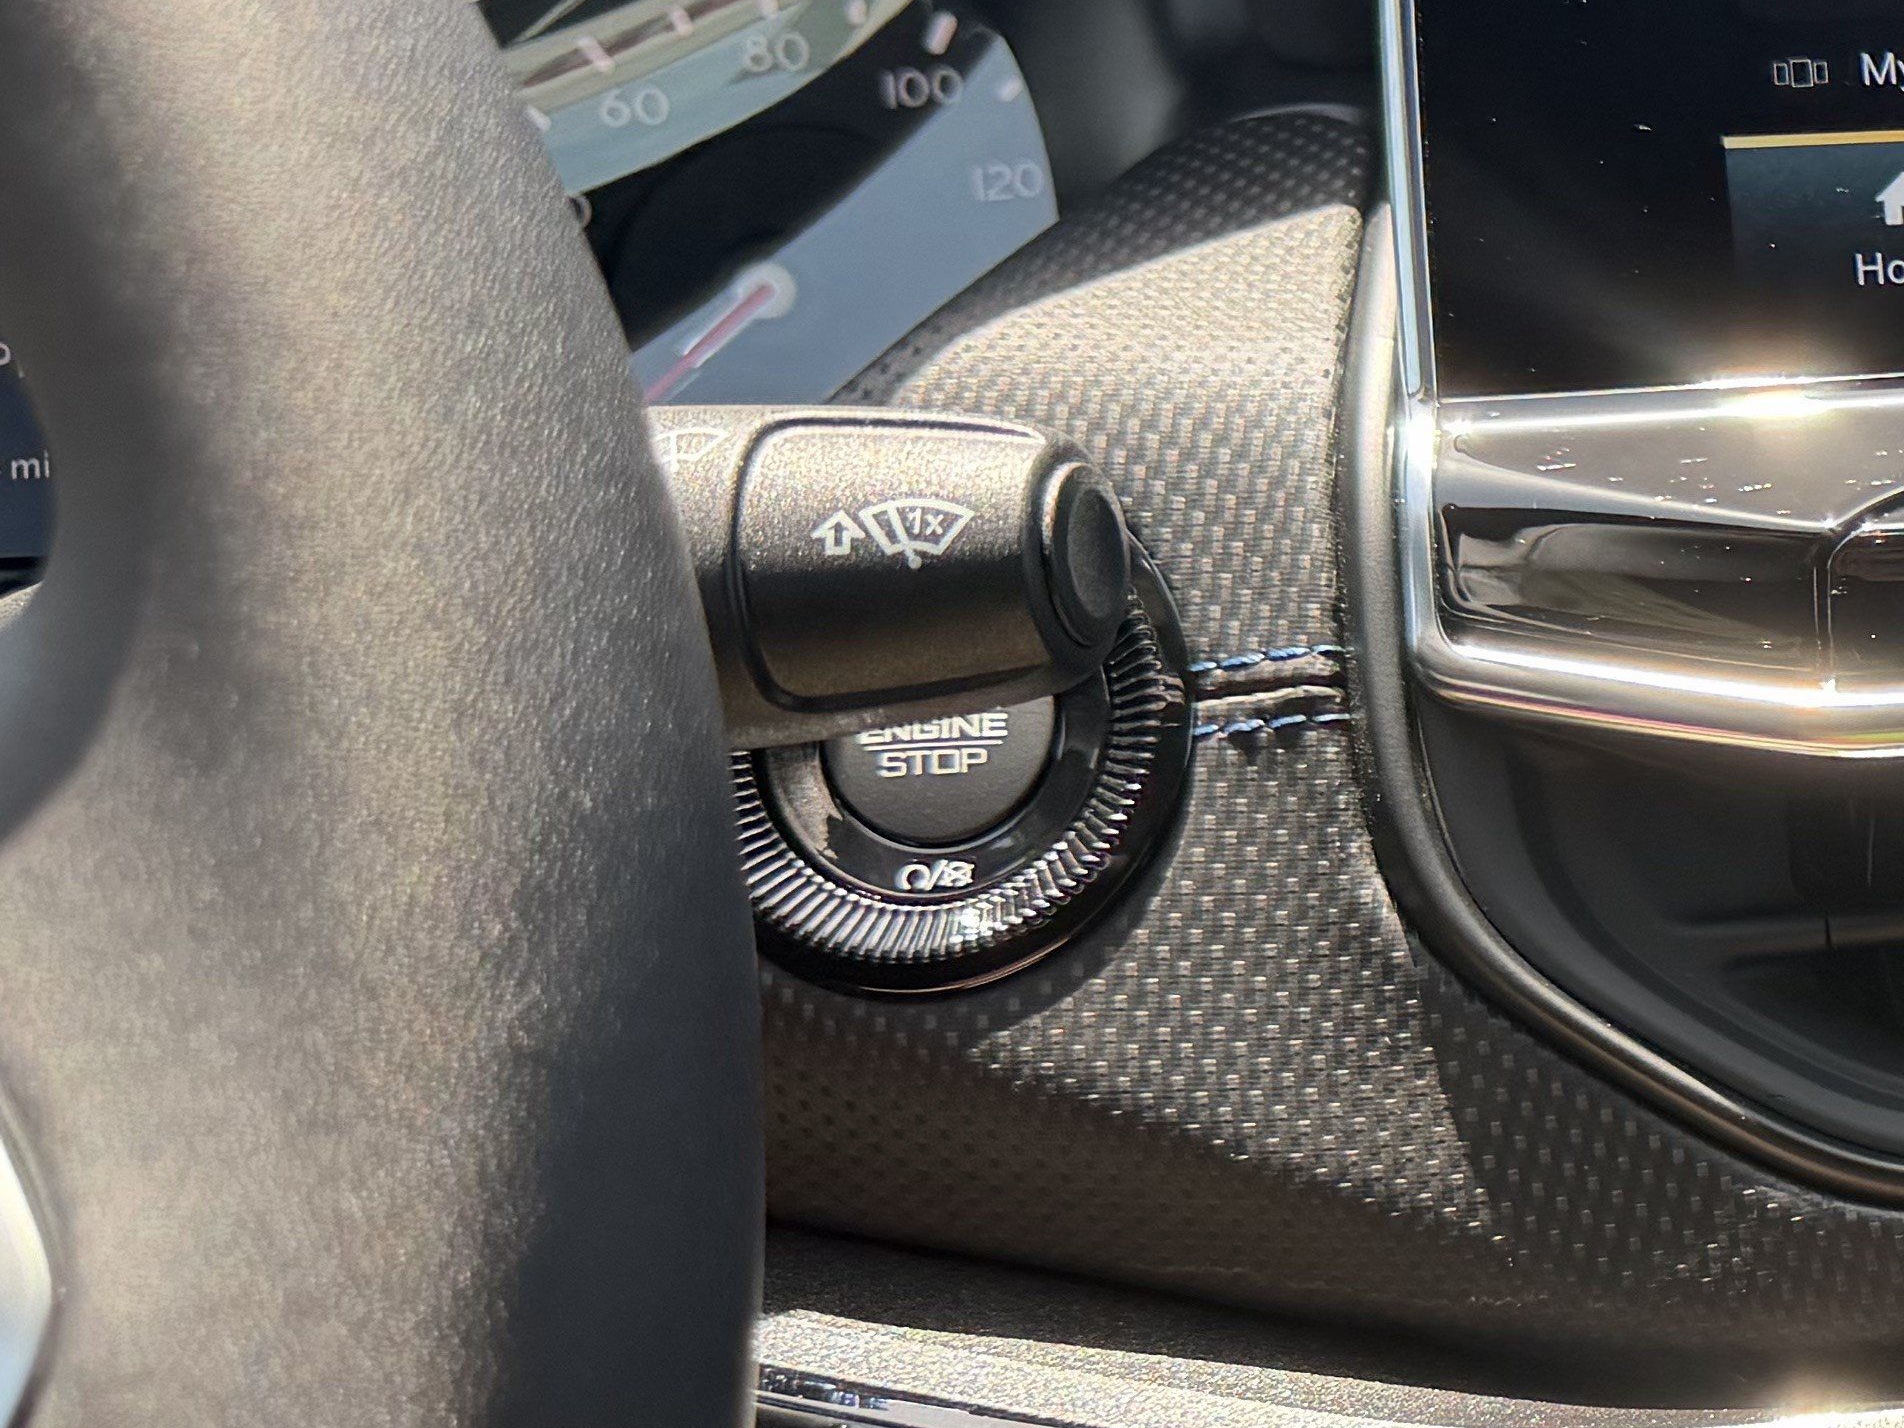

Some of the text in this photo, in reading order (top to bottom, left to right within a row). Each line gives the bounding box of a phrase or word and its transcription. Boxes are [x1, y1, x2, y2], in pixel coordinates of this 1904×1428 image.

[742, 28, 811, 73] 80
[602, 85, 671, 128] 60
[882, 66, 964, 111] 100
[971, 160, 1045, 203] 120
[10, 451, 50, 480] mi
[878, 747, 989, 778] STOP
